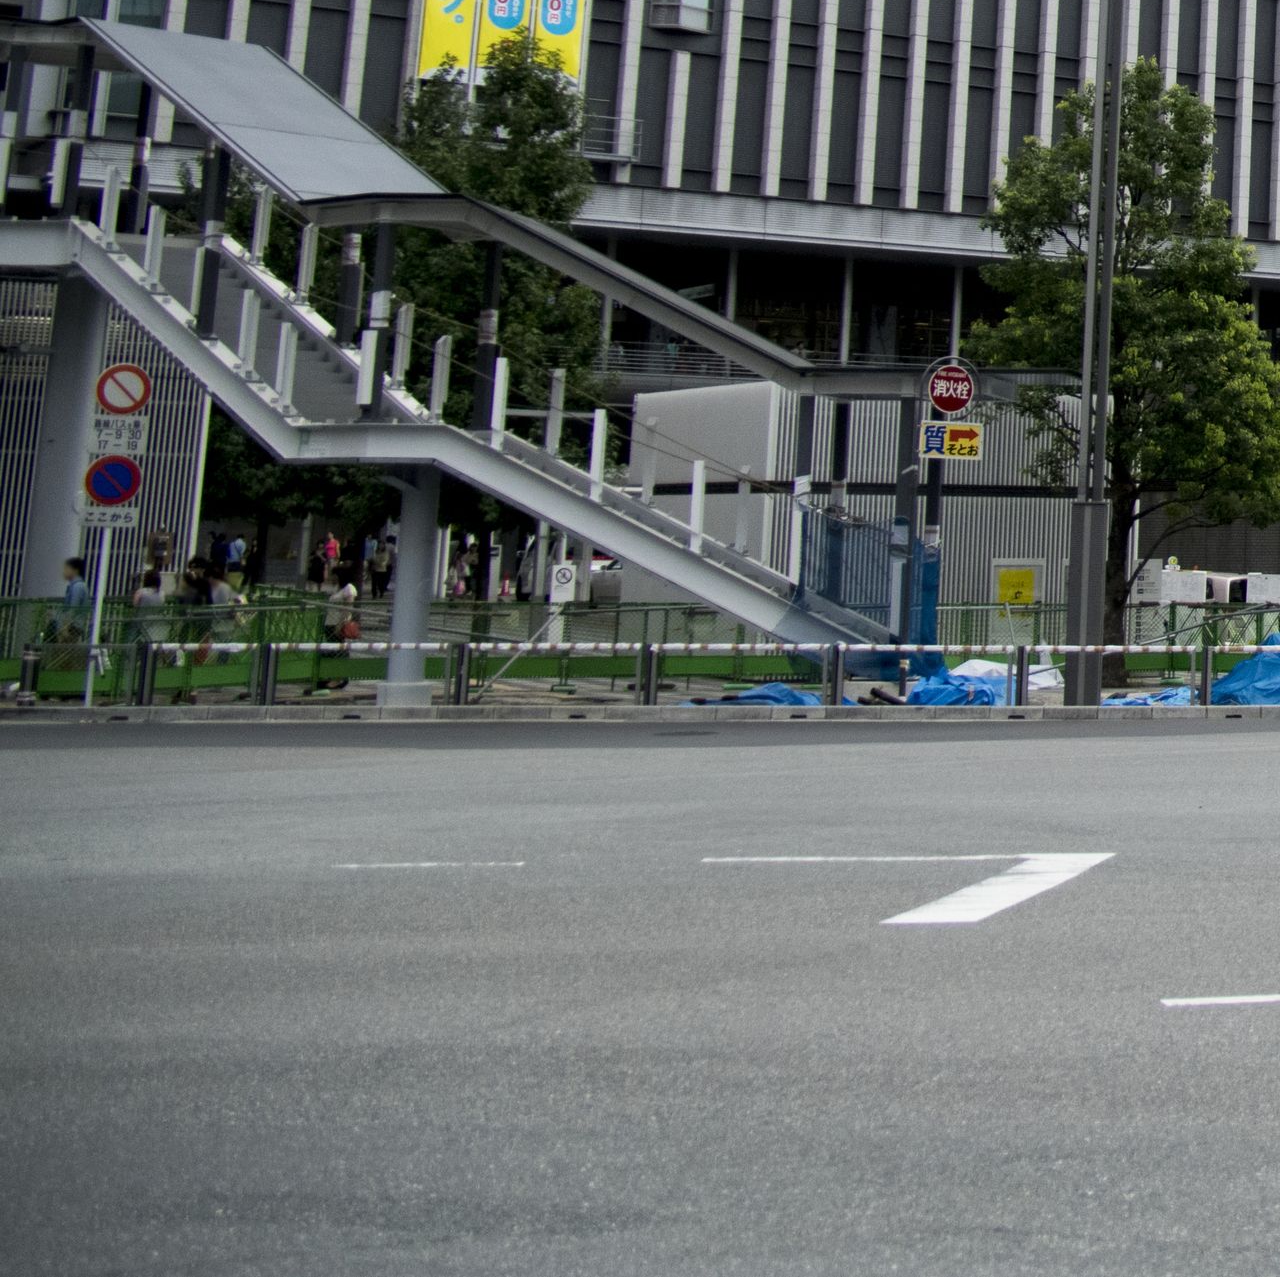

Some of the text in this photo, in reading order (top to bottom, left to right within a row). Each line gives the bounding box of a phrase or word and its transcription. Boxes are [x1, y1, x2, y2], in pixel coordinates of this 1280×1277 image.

[933, 379, 970, 399] 消火栓
[924, 425, 947, 455] 質
[946, 444, 979, 456] そとお
[84, 512, 133, 523] ここから
